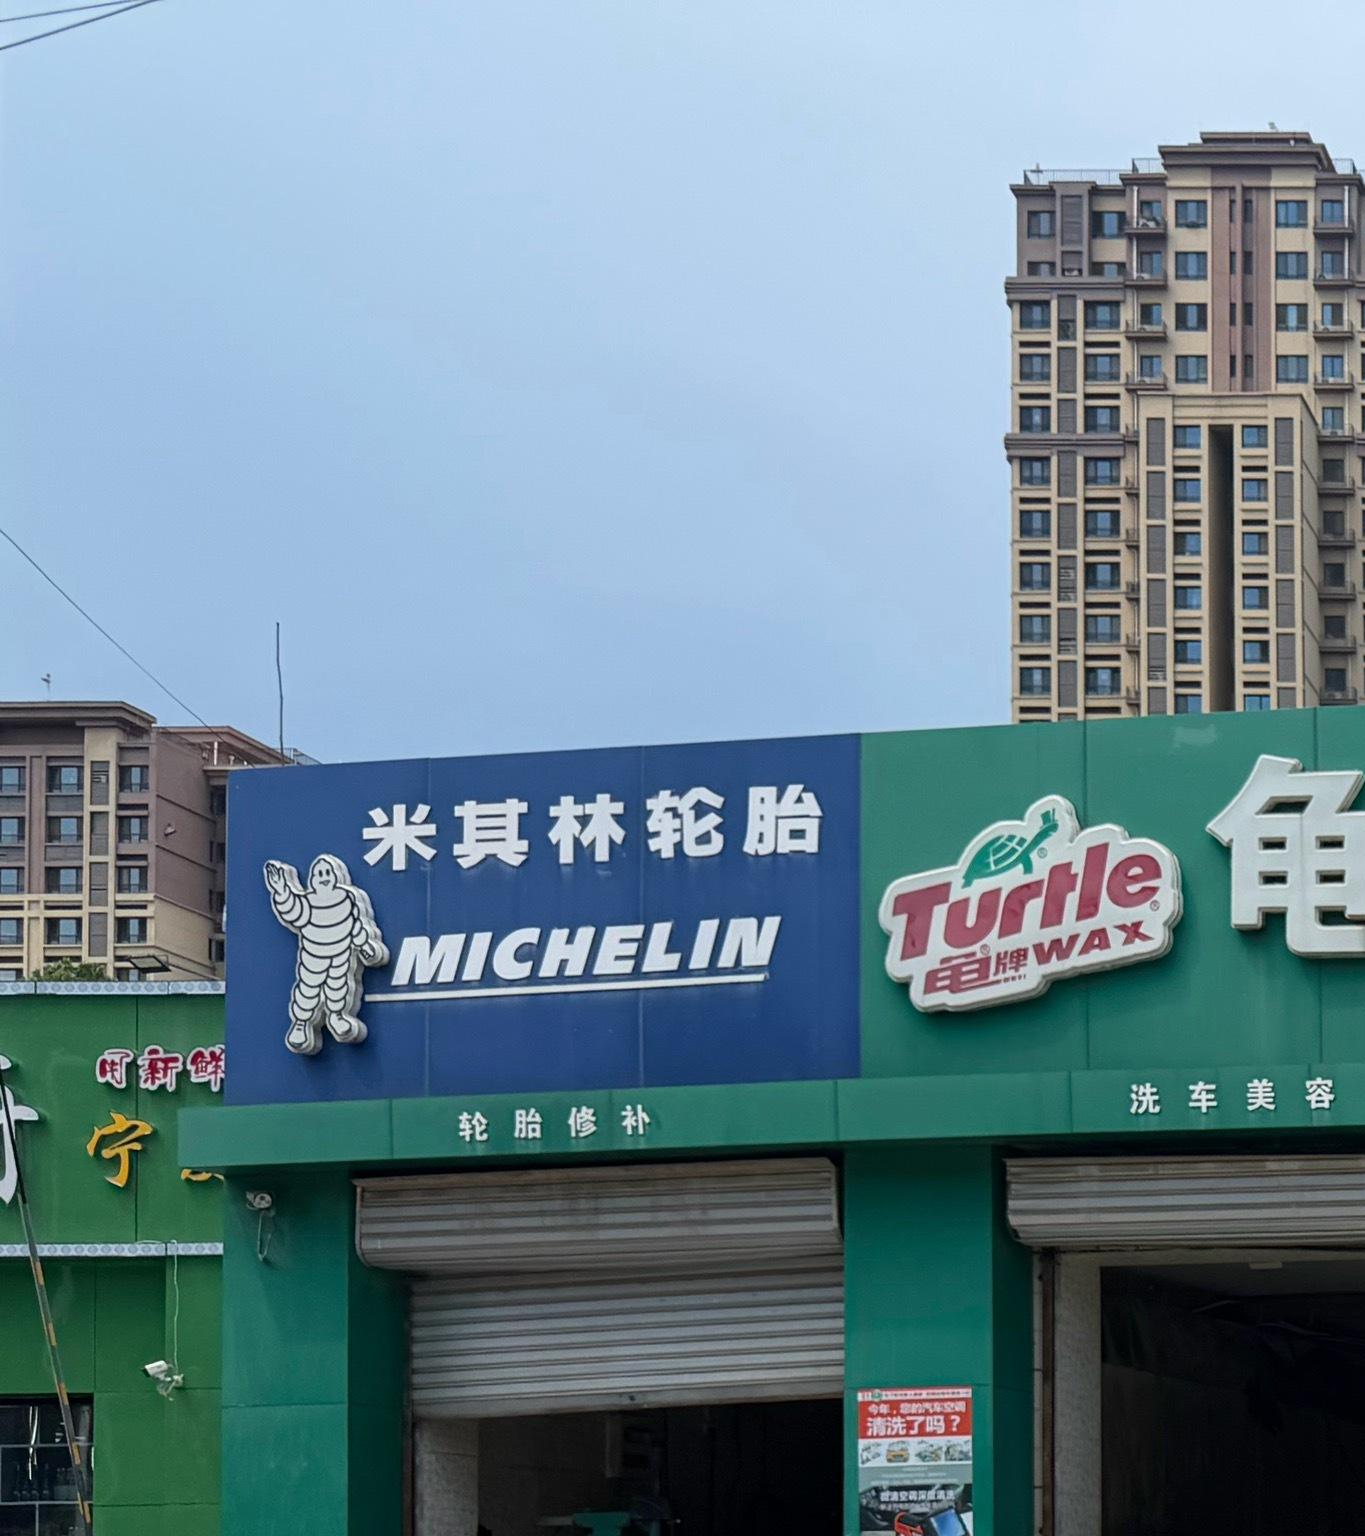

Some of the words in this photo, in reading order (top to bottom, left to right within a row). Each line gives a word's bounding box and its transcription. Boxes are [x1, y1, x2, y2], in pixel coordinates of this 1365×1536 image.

[362, 783, 823, 872] 米其林轮胎
[892, 842, 1162, 961] Turtle
[391, 915, 781, 988] MICHELIN
[1032, 920, 1156, 966] WAX
[458, 1104, 653, 1143] 轮胎修补
[1129, 1076, 1336, 1115] 洗车美容
